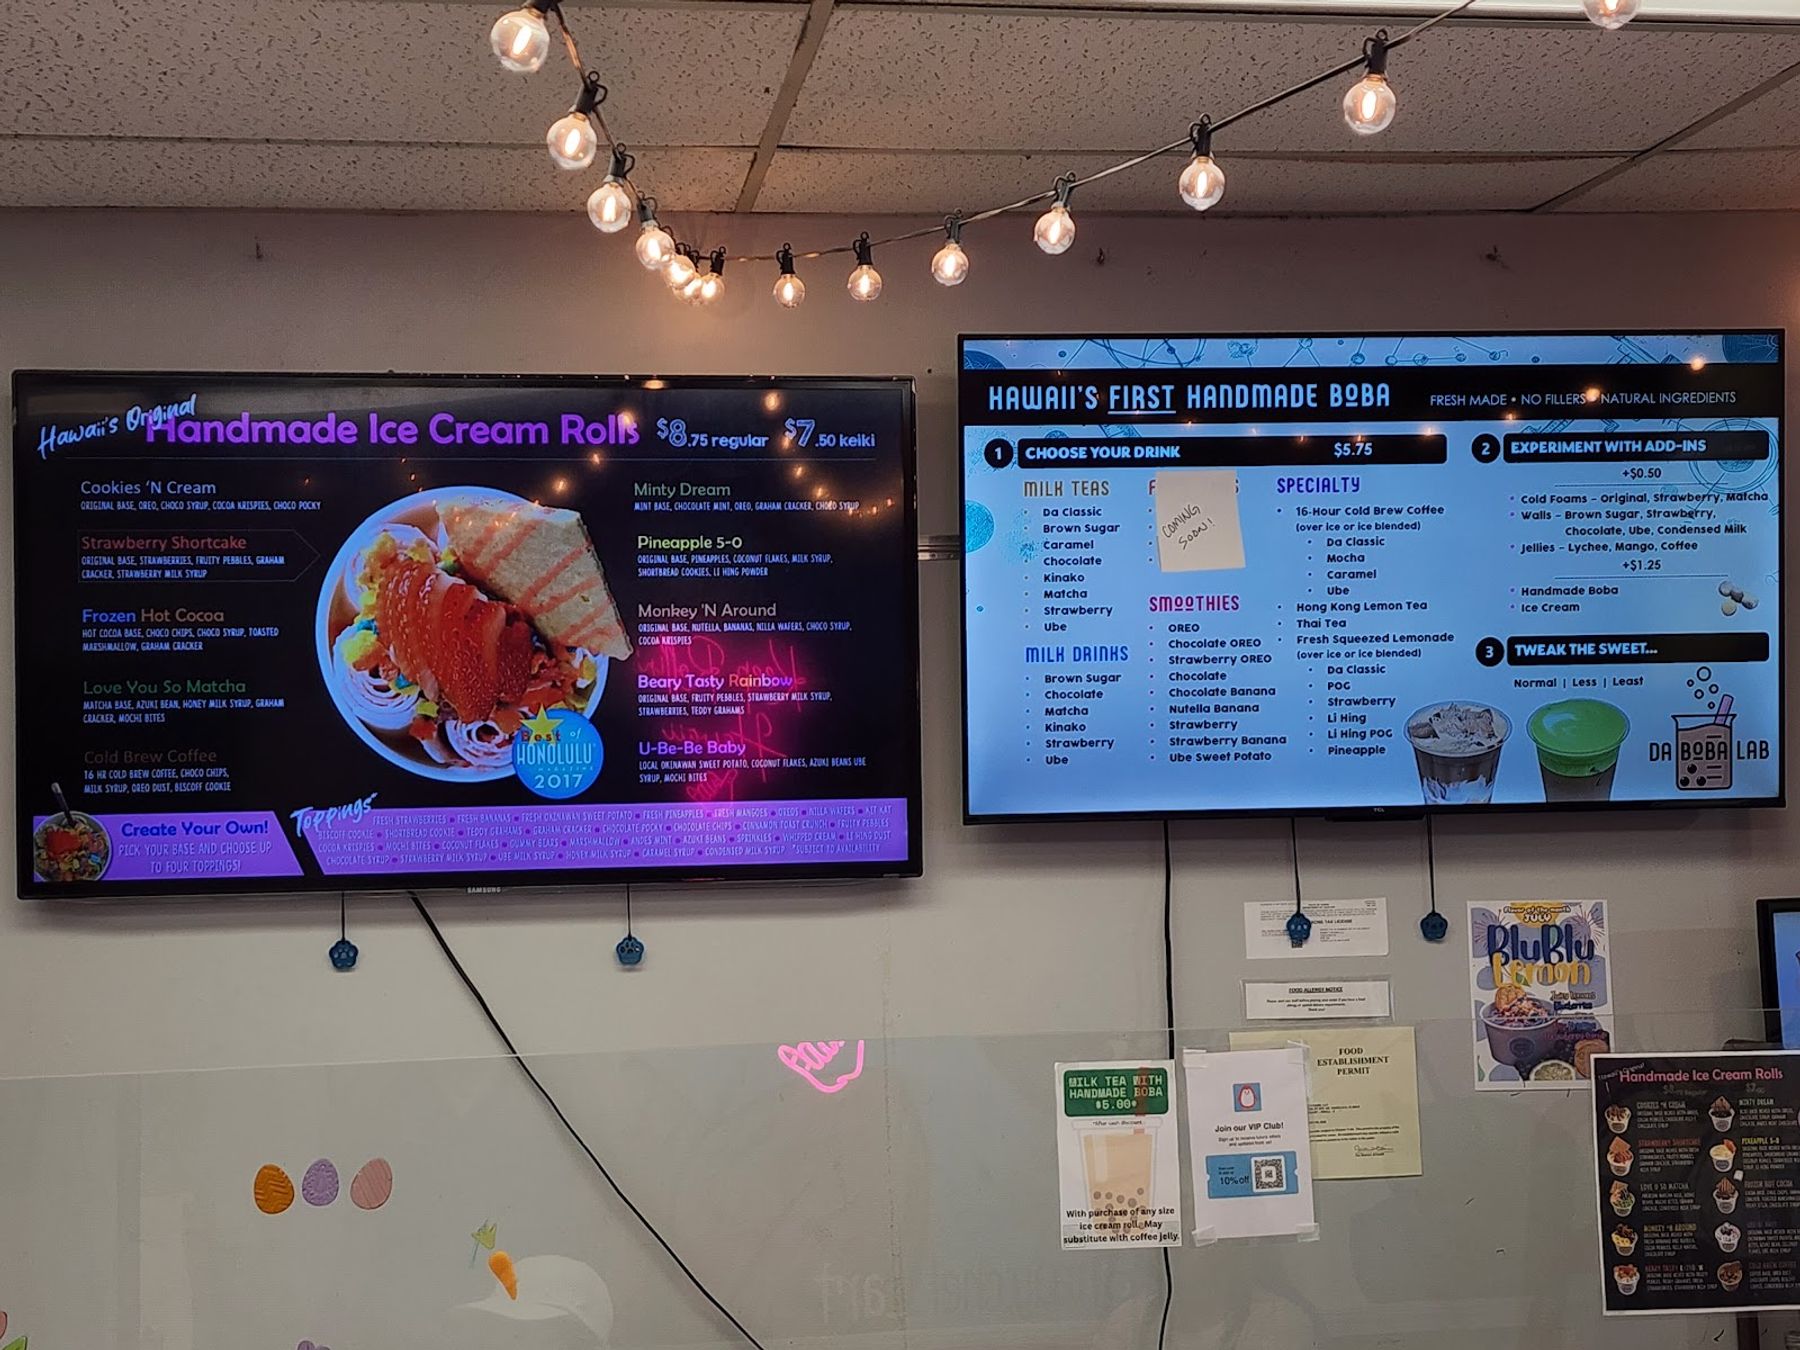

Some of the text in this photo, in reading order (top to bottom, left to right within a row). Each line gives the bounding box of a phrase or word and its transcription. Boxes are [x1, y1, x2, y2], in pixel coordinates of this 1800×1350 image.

[989, 383, 1390, 412] HAWAII'S FIRST HANDMADE BOBA
[1430, 391, 1736, 406] FRESH MADE NO FILLERS NATURAL INGREDIENTS
[36, 393, 197, 460] Hawaii's Original
[145, 410, 640, 445] Handmade Ice Cream Rolls
[839, 433, 875, 447] keiki
[1511, 439, 1706, 454] EXPERIMENT WITH ADD-INS
[994, 447, 1002, 460] 1
[1025, 446, 1180, 460] CHOOSE YOUR DRINK
[1334, 440, 1372, 458] $5.75
[1481, 442, 1490, 455] 2
[1622, 467, 1662, 480] +$0.50
[81, 480, 216, 494] Cookies ‘N Cream
[634, 482, 731, 499] Minty Dream
[1024, 480, 1109, 497] MILK TEAS
[1277, 476, 1360, 494] SPECIALTY
[80, 500, 321, 510] ORIGINAL BASE, OREO, CHOCO SYRUP, COCOA KRISPIES, CHOCO POCKY
[1043, 506, 1102, 517] Da Classic
[1296, 504, 1444, 516] 16-Hour Cold Brew Coffee
[1043, 524, 1120, 535] Brown Sugar
[1162, 504, 1215, 550] COMING SOON!
[82, 535, 247, 552] Strawberry Shortcake
[638, 535, 742, 551] Pineapple 5-0
[1521, 585, 1618, 596] Handmade Boba
[1149, 595, 1239, 612] SMOOTHIES
[1521, 603, 1580, 612] Ice Cream
[82, 608, 224, 623] Frozen Hot Cocoa
[638, 603, 776, 620] Monkey 'N Around
[82, 641, 203, 652] MARSHMALLOW, GRAHAM CRACKER
[1485, 646, 1494, 658] 3
[1514, 642, 1658, 656] TWEAK THE SWEET...
[1026, 646, 1128, 663] MILK DRINKS
[84, 679, 246, 694] Love You So Matcha
[638, 673, 793, 690] Beary Tasty Rainbow
[1514, 676, 1644, 688] Normal Less Least
[570, 728, 581, 739] of
[516, 743, 592, 765] HONOLULU
[639, 740, 746, 756] U-Be-Be Baby
[1649, 740, 1769, 762] DA BOBA LAB
[84, 748, 217, 764] Cold Brew Coffee
[1169, 751, 1272, 762] Ube Sweet Potato
[534, 774, 583, 789] 2017
[121, 820, 269, 837] Create Your Own!
[1487, 924, 1595, 966] BluBlu
[1492, 951, 1592, 989] Lemon
[1339, 1047, 1363, 1055] FOOD
[1317, 1055, 1389, 1066] ESTABLISHMENT
[1337, 1067, 1370, 1075] PERMIT
[1619, 1070, 1689, 1082] Handmade
[1692, 1070, 1709, 1081] Ice
[1712, 1069, 1752, 1080] Cream
[1755, 1068, 1783, 1080] Rolls
[1069, 1075, 1163, 1087] MILK TEA WITH
[1069, 1086, 1163, 1099] HANDMADE BOBA
[1215, 1125, 1232, 1133] Join
[1263, 1122, 1284, 1130] Club!
[1220, 1176, 1238, 1185] 10%
[1066, 1210, 1087, 1218] With
[1088, 1208, 1128, 1218] purchase
[1141, 1208, 1156, 1217] any
[1158, 1207, 1175, 1215] size
[1079, 1222, 1092, 1230] ice
[1094, 1222, 1121, 1230] cream
[1144, 1220, 1163, 1229] May
[1063, 1231, 1180, 1244] substitute with coffee jelly.
